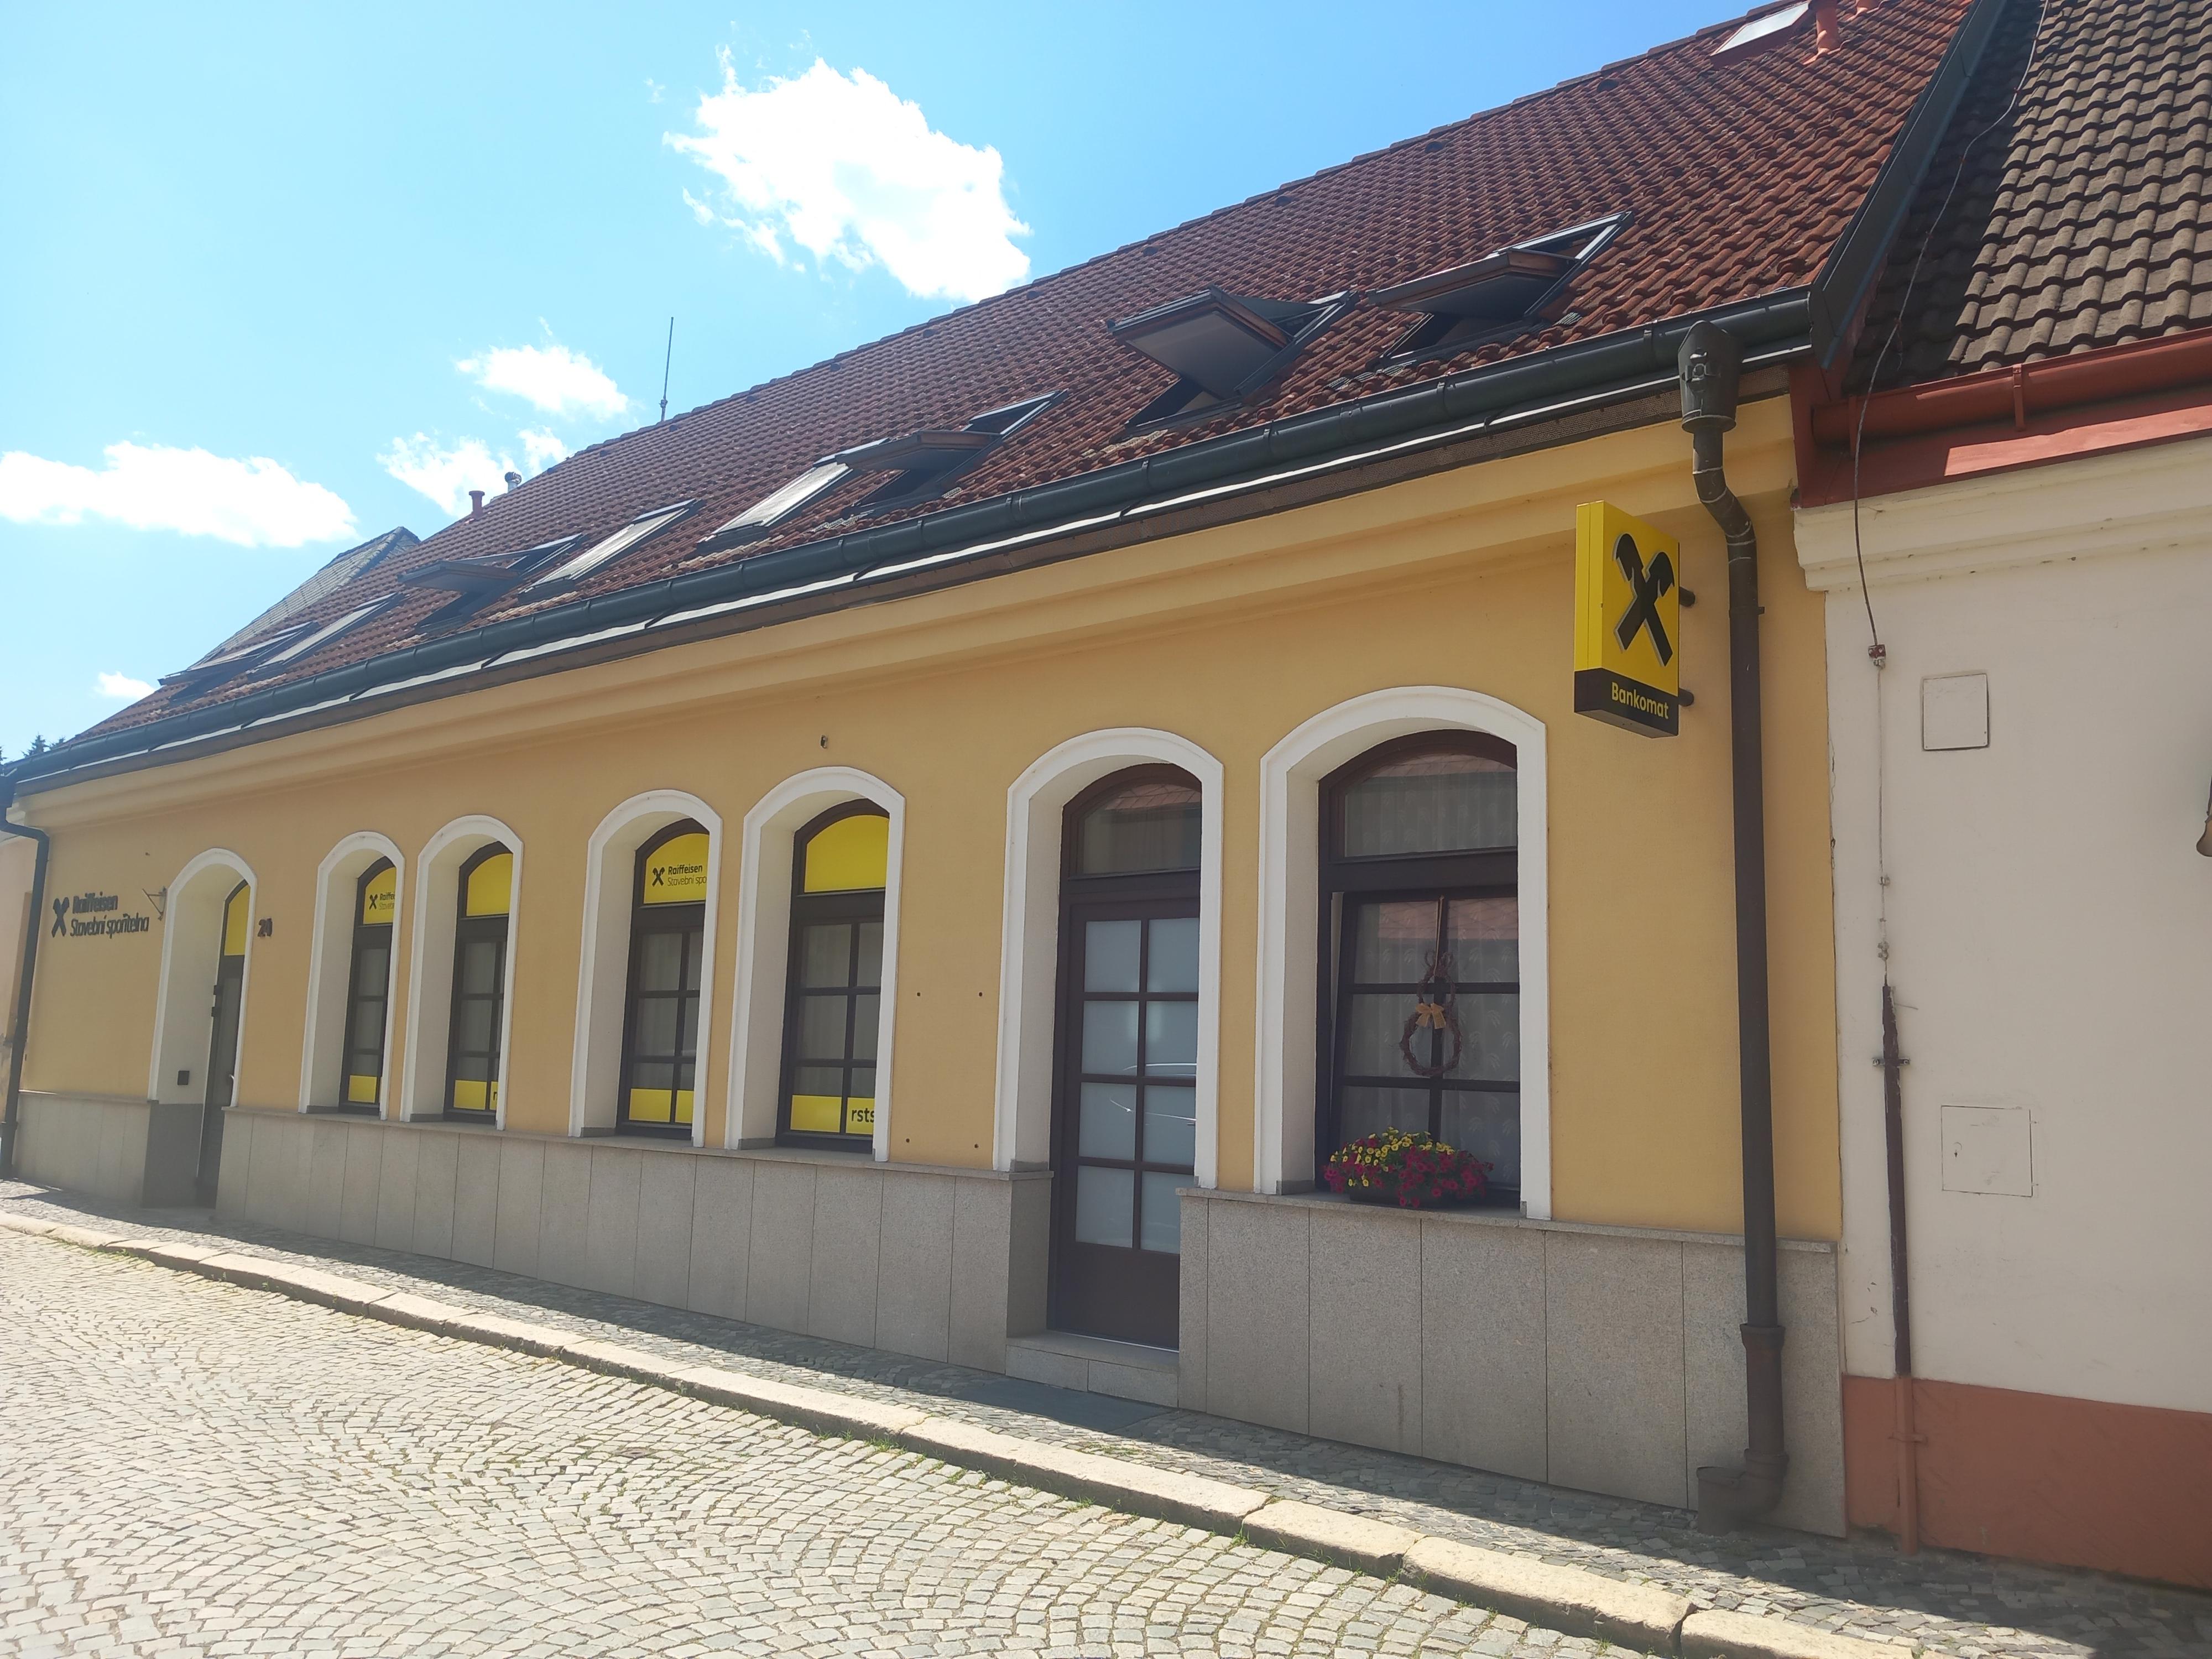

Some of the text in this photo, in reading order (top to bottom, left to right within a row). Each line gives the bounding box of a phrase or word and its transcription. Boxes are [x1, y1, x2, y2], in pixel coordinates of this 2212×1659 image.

[1611, 681, 1669, 719] Bankomat
[668, 863, 703, 875] Raiffeisen
[72, 891, 118, 914] Raiffeisen
[70, 912, 149, 939] Stavební spořitelna
